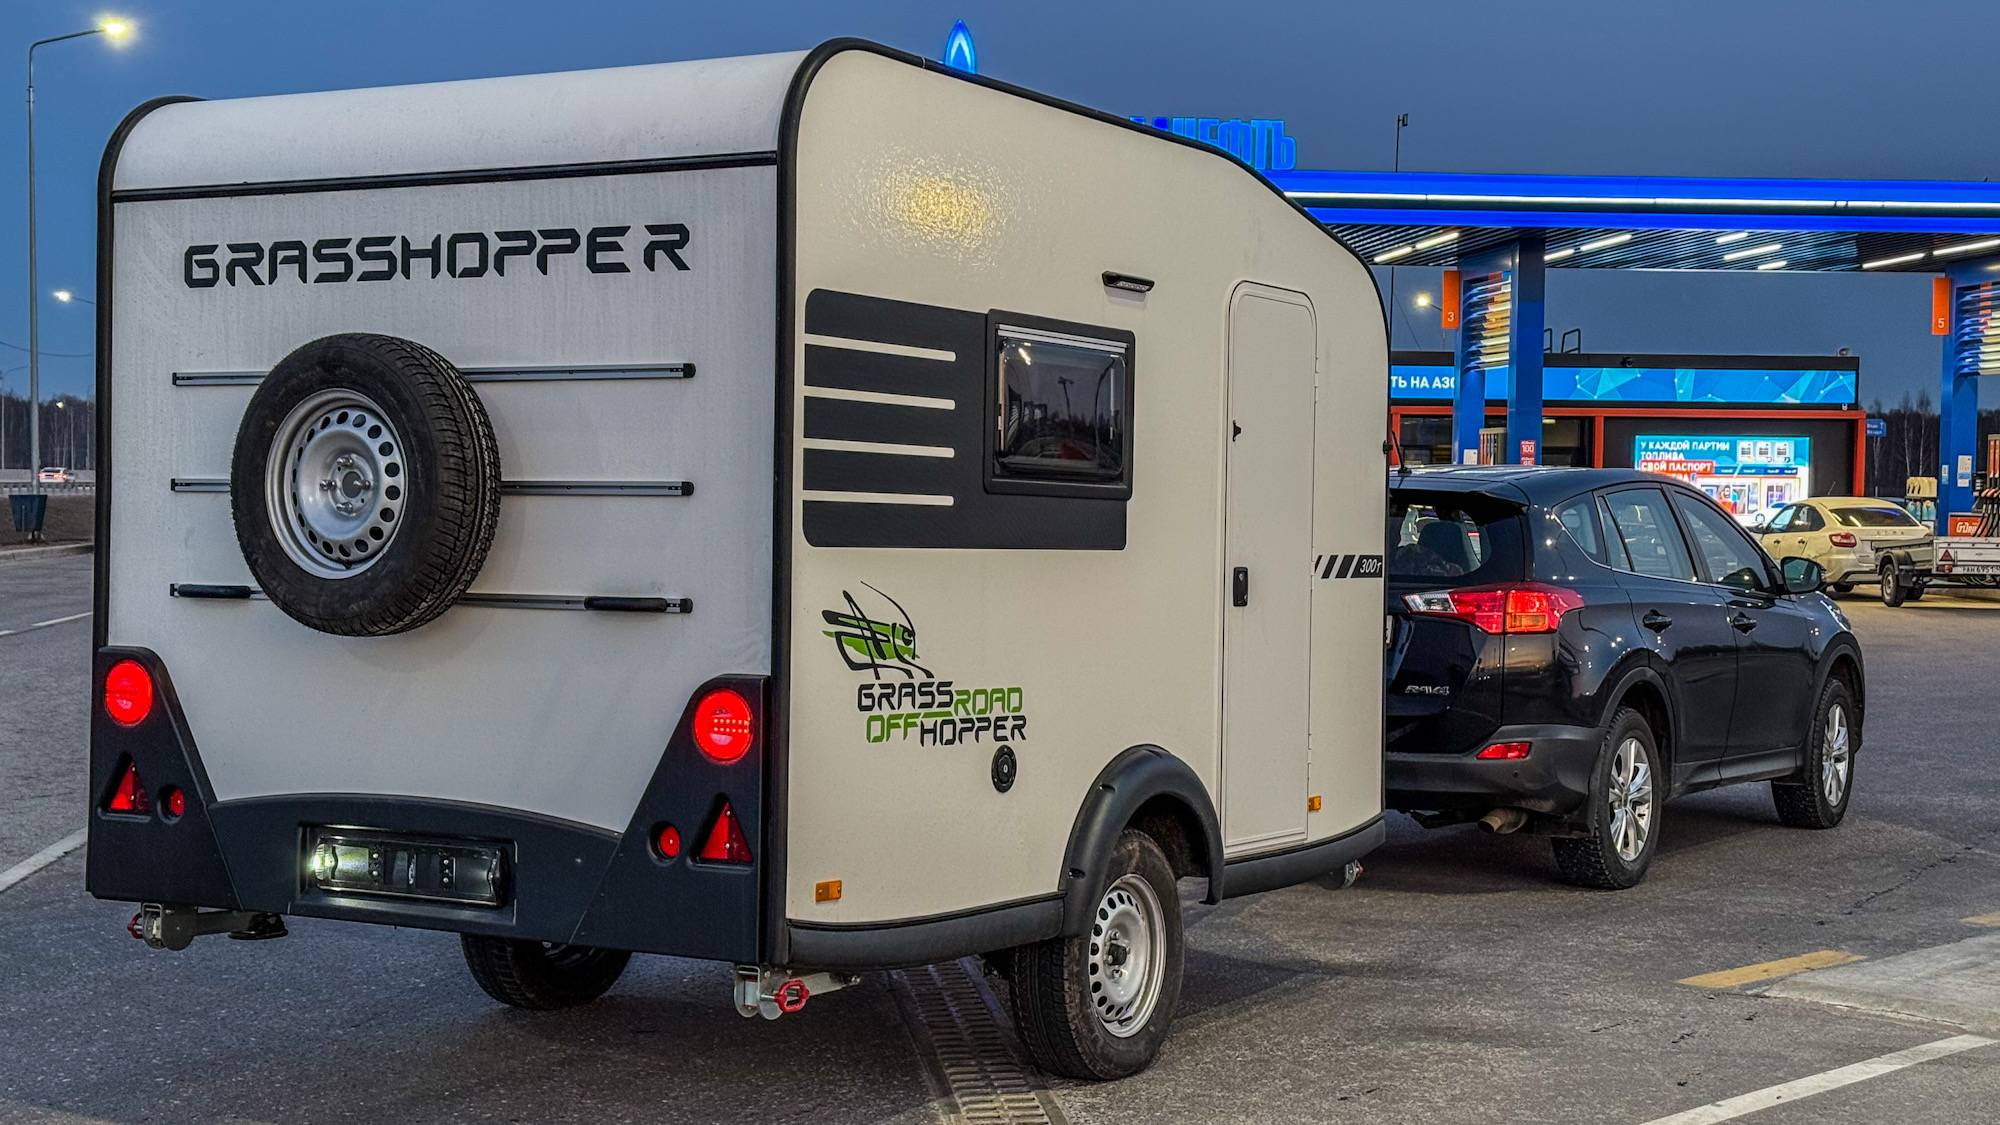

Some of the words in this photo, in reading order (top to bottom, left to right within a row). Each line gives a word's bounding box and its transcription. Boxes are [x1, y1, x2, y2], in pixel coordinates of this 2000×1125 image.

[184, 223, 691, 289] GRASSHOPPER
[1447, 311, 1455, 322] 3
[1937, 317, 1945, 329] 5
[1410, 376, 1430, 389] НА
[1522, 444, 1535, 454] 100
[1648, 440, 1690, 451] КАЖДОЙ
[1641, 461, 1667, 471] СВОЙ
[1669, 463, 1712, 471] ПАСПОРТ
[857, 681, 953, 712] GRASS
[954, 687, 1023, 716] ROAD
[920, 715, 1027, 747] HOPPER
